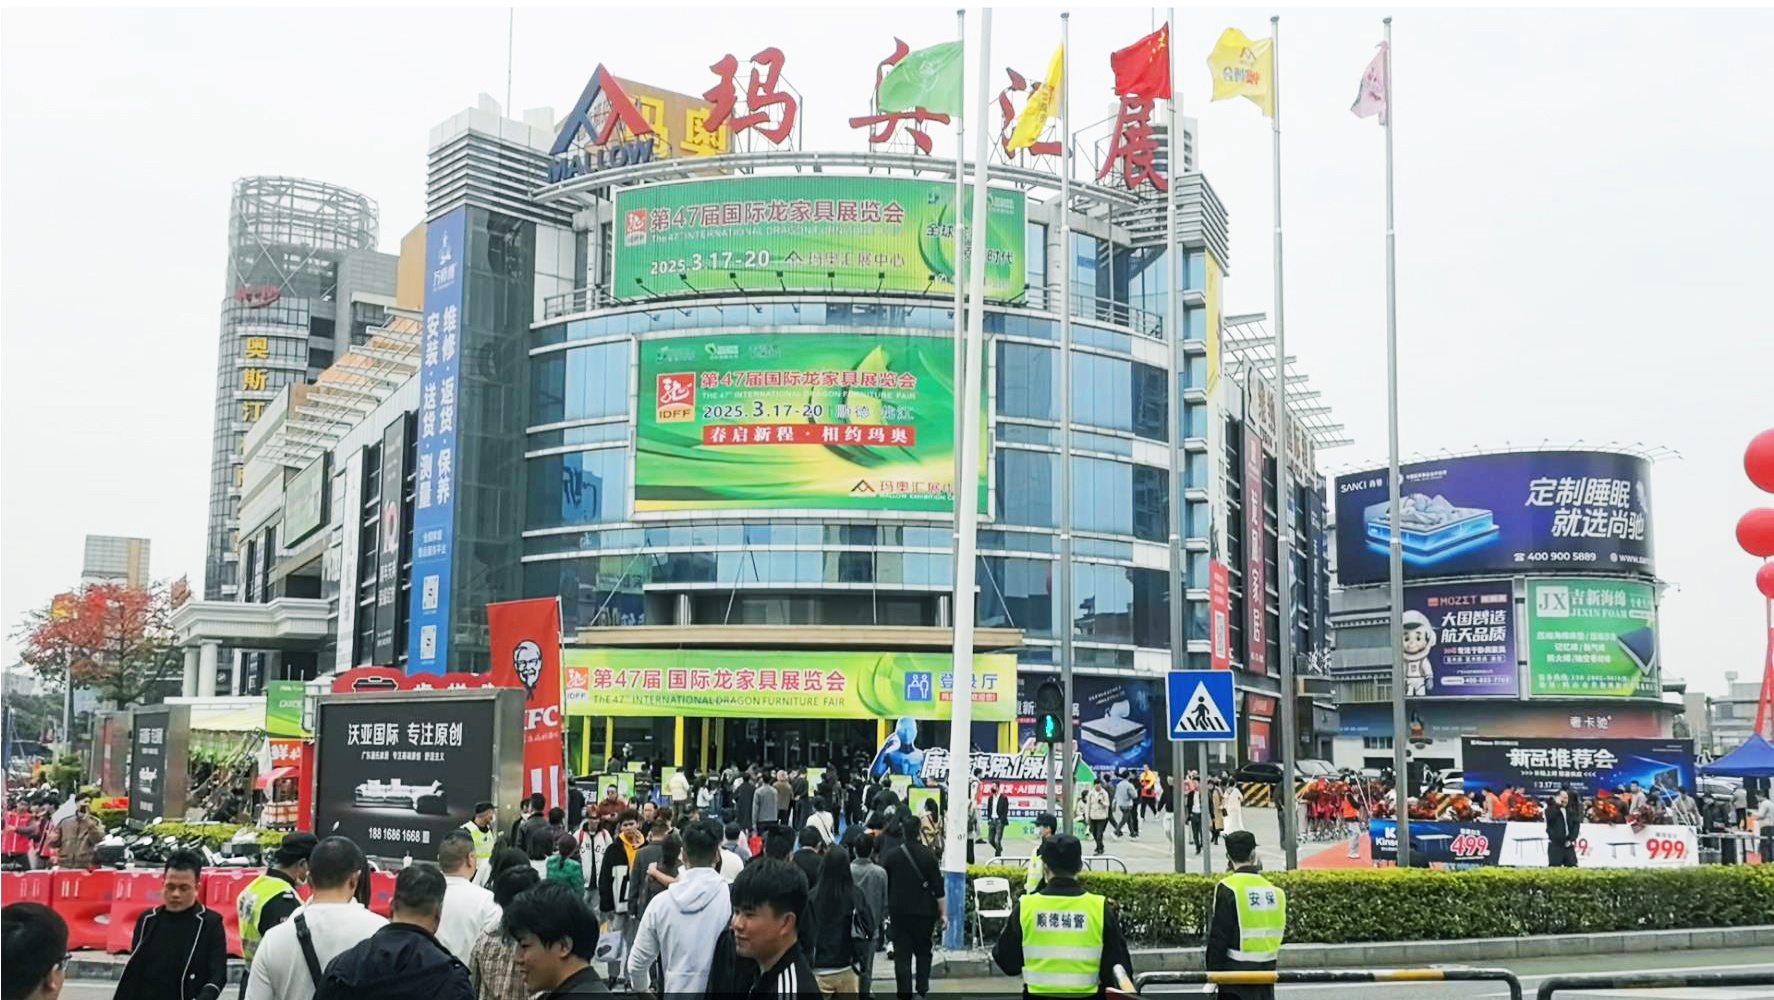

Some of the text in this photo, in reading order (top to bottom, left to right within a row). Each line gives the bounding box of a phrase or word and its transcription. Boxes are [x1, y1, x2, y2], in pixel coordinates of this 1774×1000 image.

[547, 138, 654, 184] MALLOW
[650, 199, 904, 231] 第47届国际龙家具展览会
[651, 250, 770, 275] 2025.3.17-20
[701, 371, 917, 389] 第47届国际龙家具展览会
[659, 409, 691, 419] IDFF
[703, 400, 824, 418] 2025.3.17-20
[1340, 481, 1367, 493] SANCI
[1525, 476, 1631, 509] 定制睡眠
[1551, 509, 1645, 541] 就选尚驰
[1527, 552, 1548, 562] 400
[1551, 552, 1570, 562] 900
[1572, 552, 1597, 562] 5889
[1539, 593, 1567, 610] JX
[1441, 610, 1507, 627] 大国智造
[1570, 608, 1628, 618] JIXIN FOAM
[1441, 626, 1507, 643] 航天品质
[593, 668, 846, 692] 第47届国际龙家具展览会
[633, 694, 713, 705] INTERNATIONAL
[715, 695, 760, 706] DRAGON
[762, 695, 819, 706] FURNITURE
[824, 696, 845, 706] FAIR
[524, 705, 559, 730] FC
[348, 722, 462, 747] 沃亚国际 专注原创
[1506, 748, 1618, 770] 新品推荐会
[368, 827, 421, 842] 188 1686 1668
[1450, 835, 1488, 857] 499
[1646, 838, 1685, 860] 999
[1249, 890, 1277, 907] 安保
[1036, 911, 1084, 930] 顺德辅警
